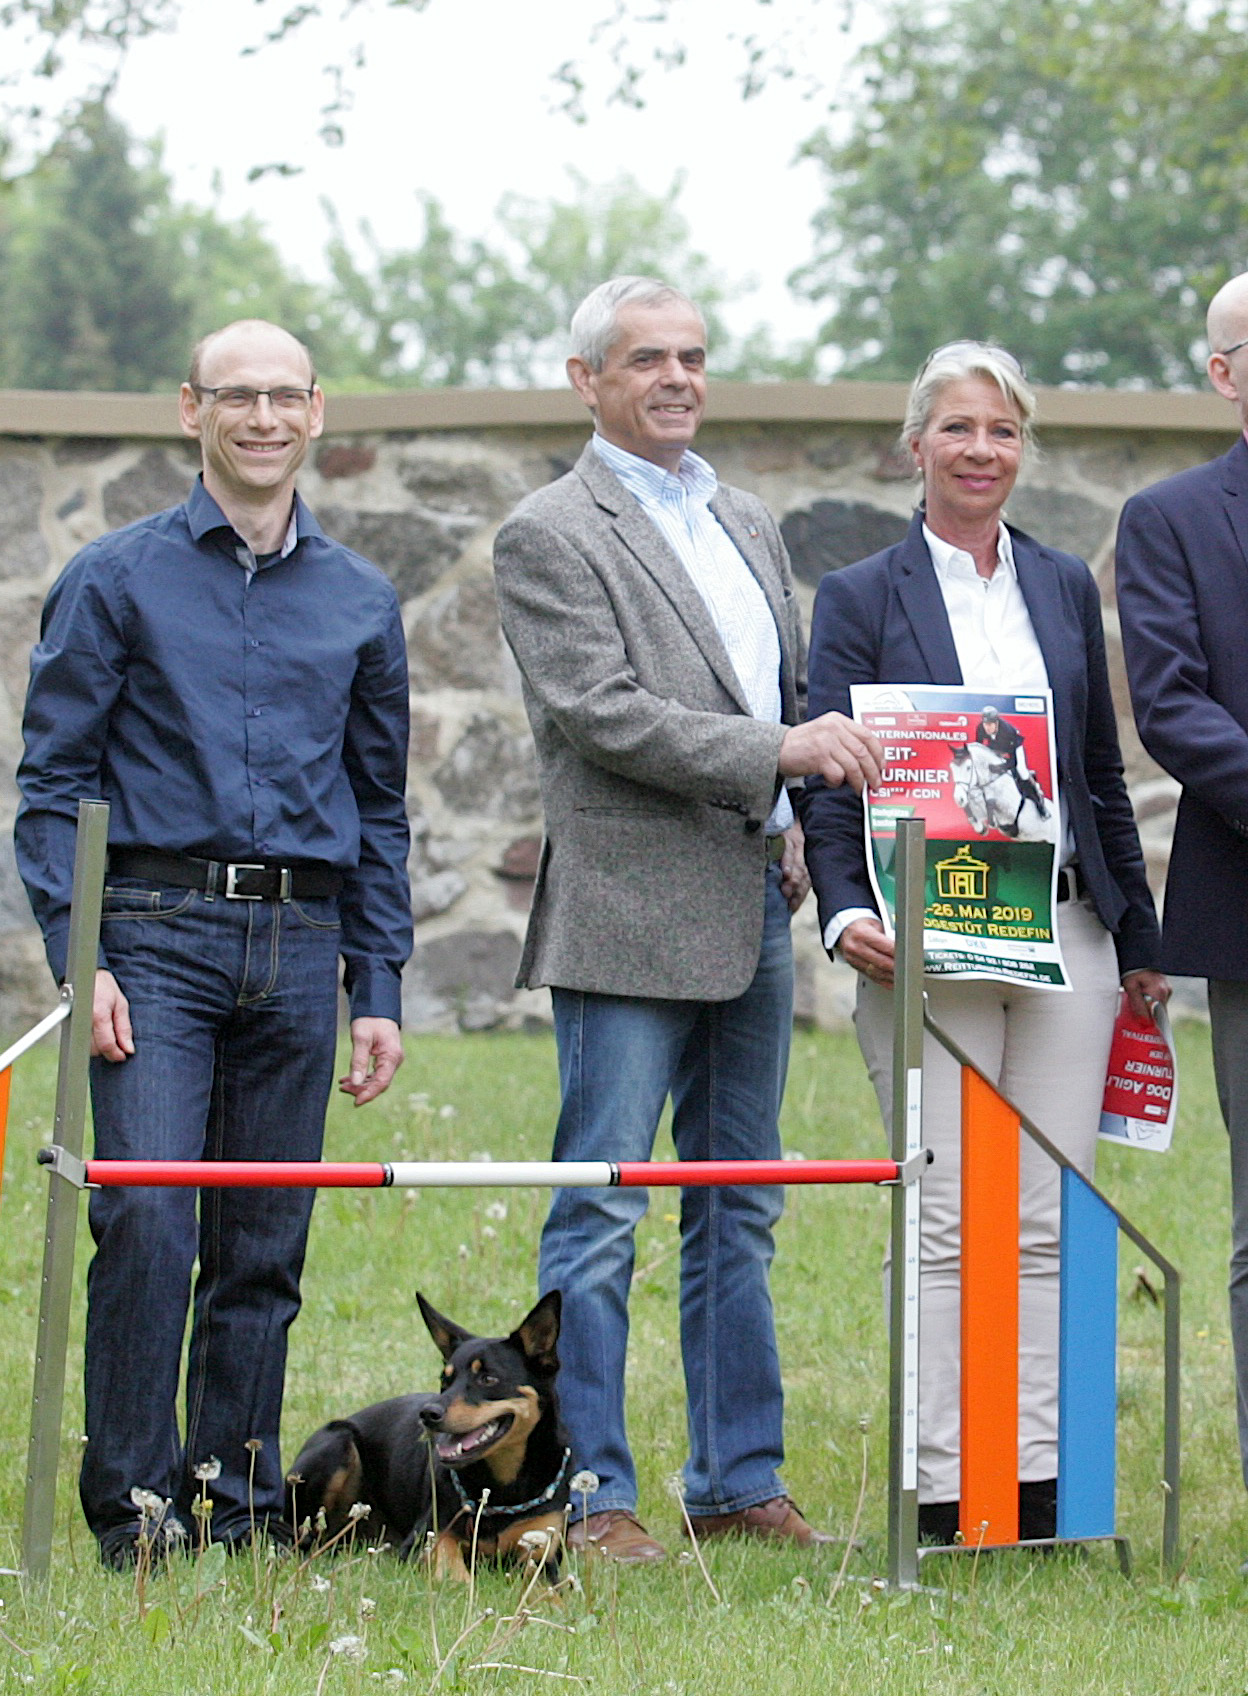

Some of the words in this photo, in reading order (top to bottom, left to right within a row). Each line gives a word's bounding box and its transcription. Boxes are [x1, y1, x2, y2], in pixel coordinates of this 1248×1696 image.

[871, 730, 968, 741] NTERNATIONALES
[884, 746, 917, 761] EIT-
[881, 768, 949, 783] URNIER
[912, 788, 941, 799] CDN
[991, 905, 1033, 922] 2019
[923, 917, 983, 935] DGESTÜT
[987, 922, 1051, 940] REDEFIN
[1124, 1060, 1173, 1080] TURNIER
[1106, 1075, 1145, 1095] AGILI
[1145, 1083, 1172, 1100] DOG
